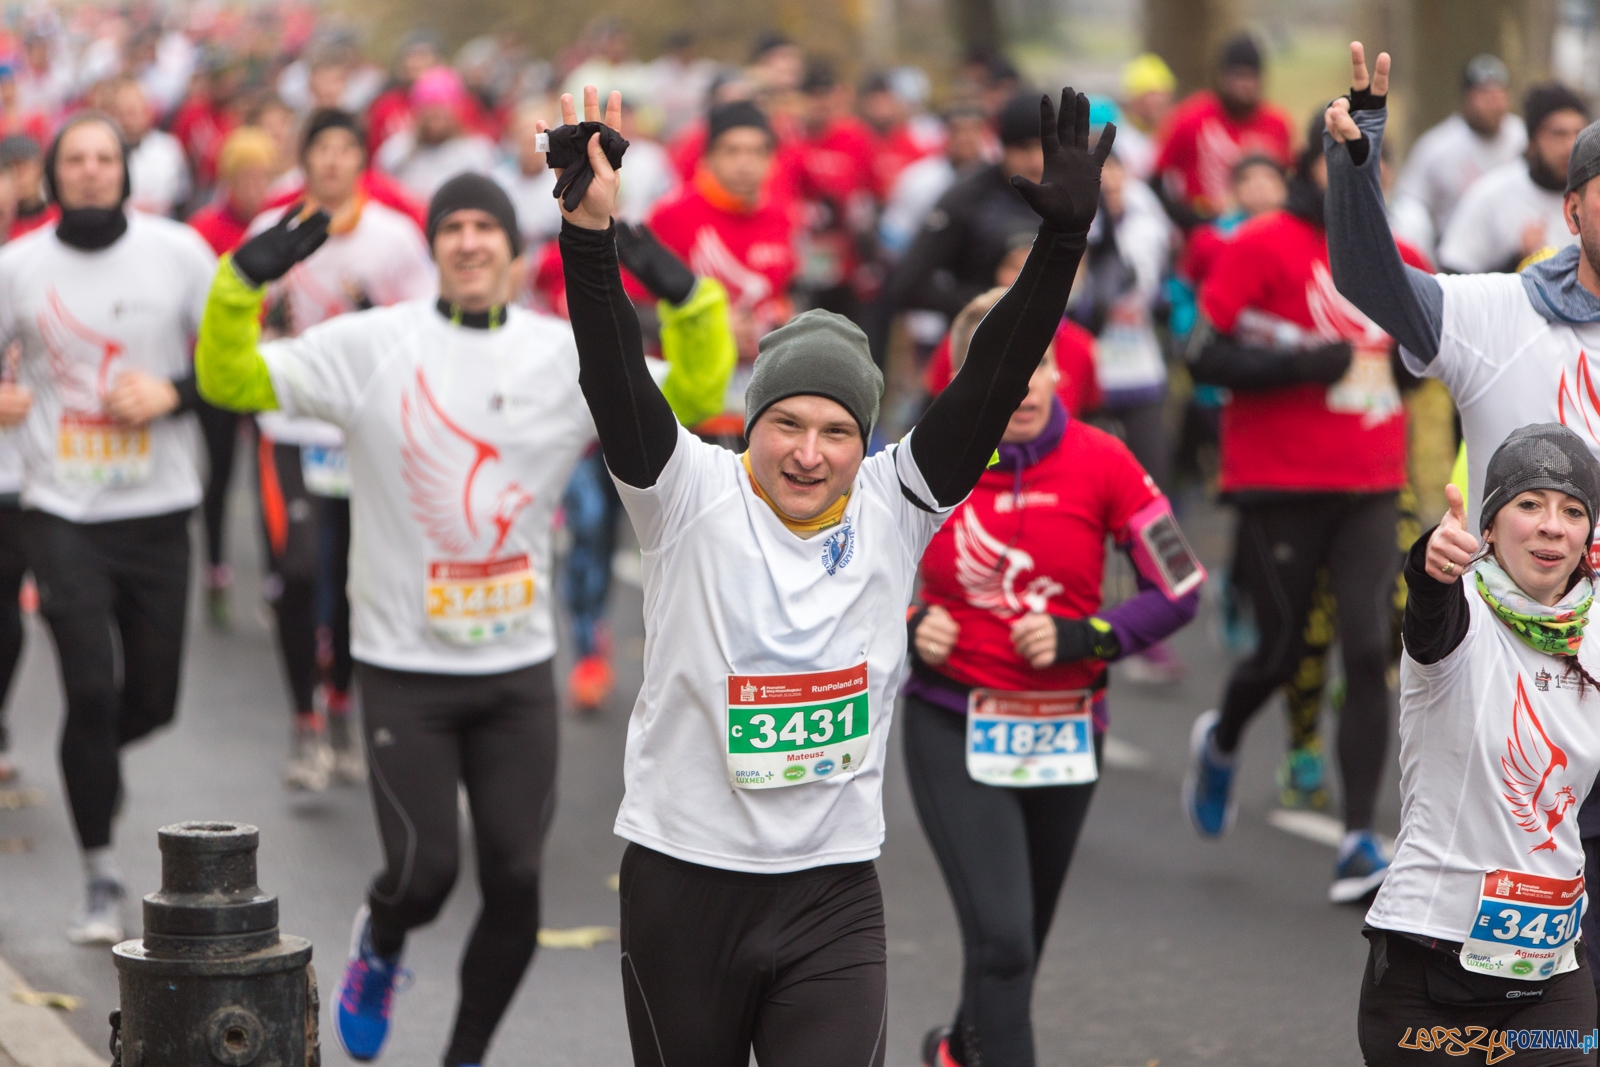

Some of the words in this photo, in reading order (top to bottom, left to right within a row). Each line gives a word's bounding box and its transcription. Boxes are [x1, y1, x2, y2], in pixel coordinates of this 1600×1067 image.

[811, 676, 864, 693] RunPoland.org
[760, 685, 768, 698] 1
[731, 725, 743, 738] C
[749, 702, 854, 749] 3431
[987, 722, 1079, 755] 1824
[786, 751, 825, 762] Mateusz
[1515, 882, 1522, 895] 1
[1478, 915, 1491, 926] E
[1492, 907, 1577, 945] 3430
[1467, 953, 1491, 962] GRUPA
[1514, 949, 1555, 959] Agnieszka
[1466, 959, 1494, 970] LUXMED
